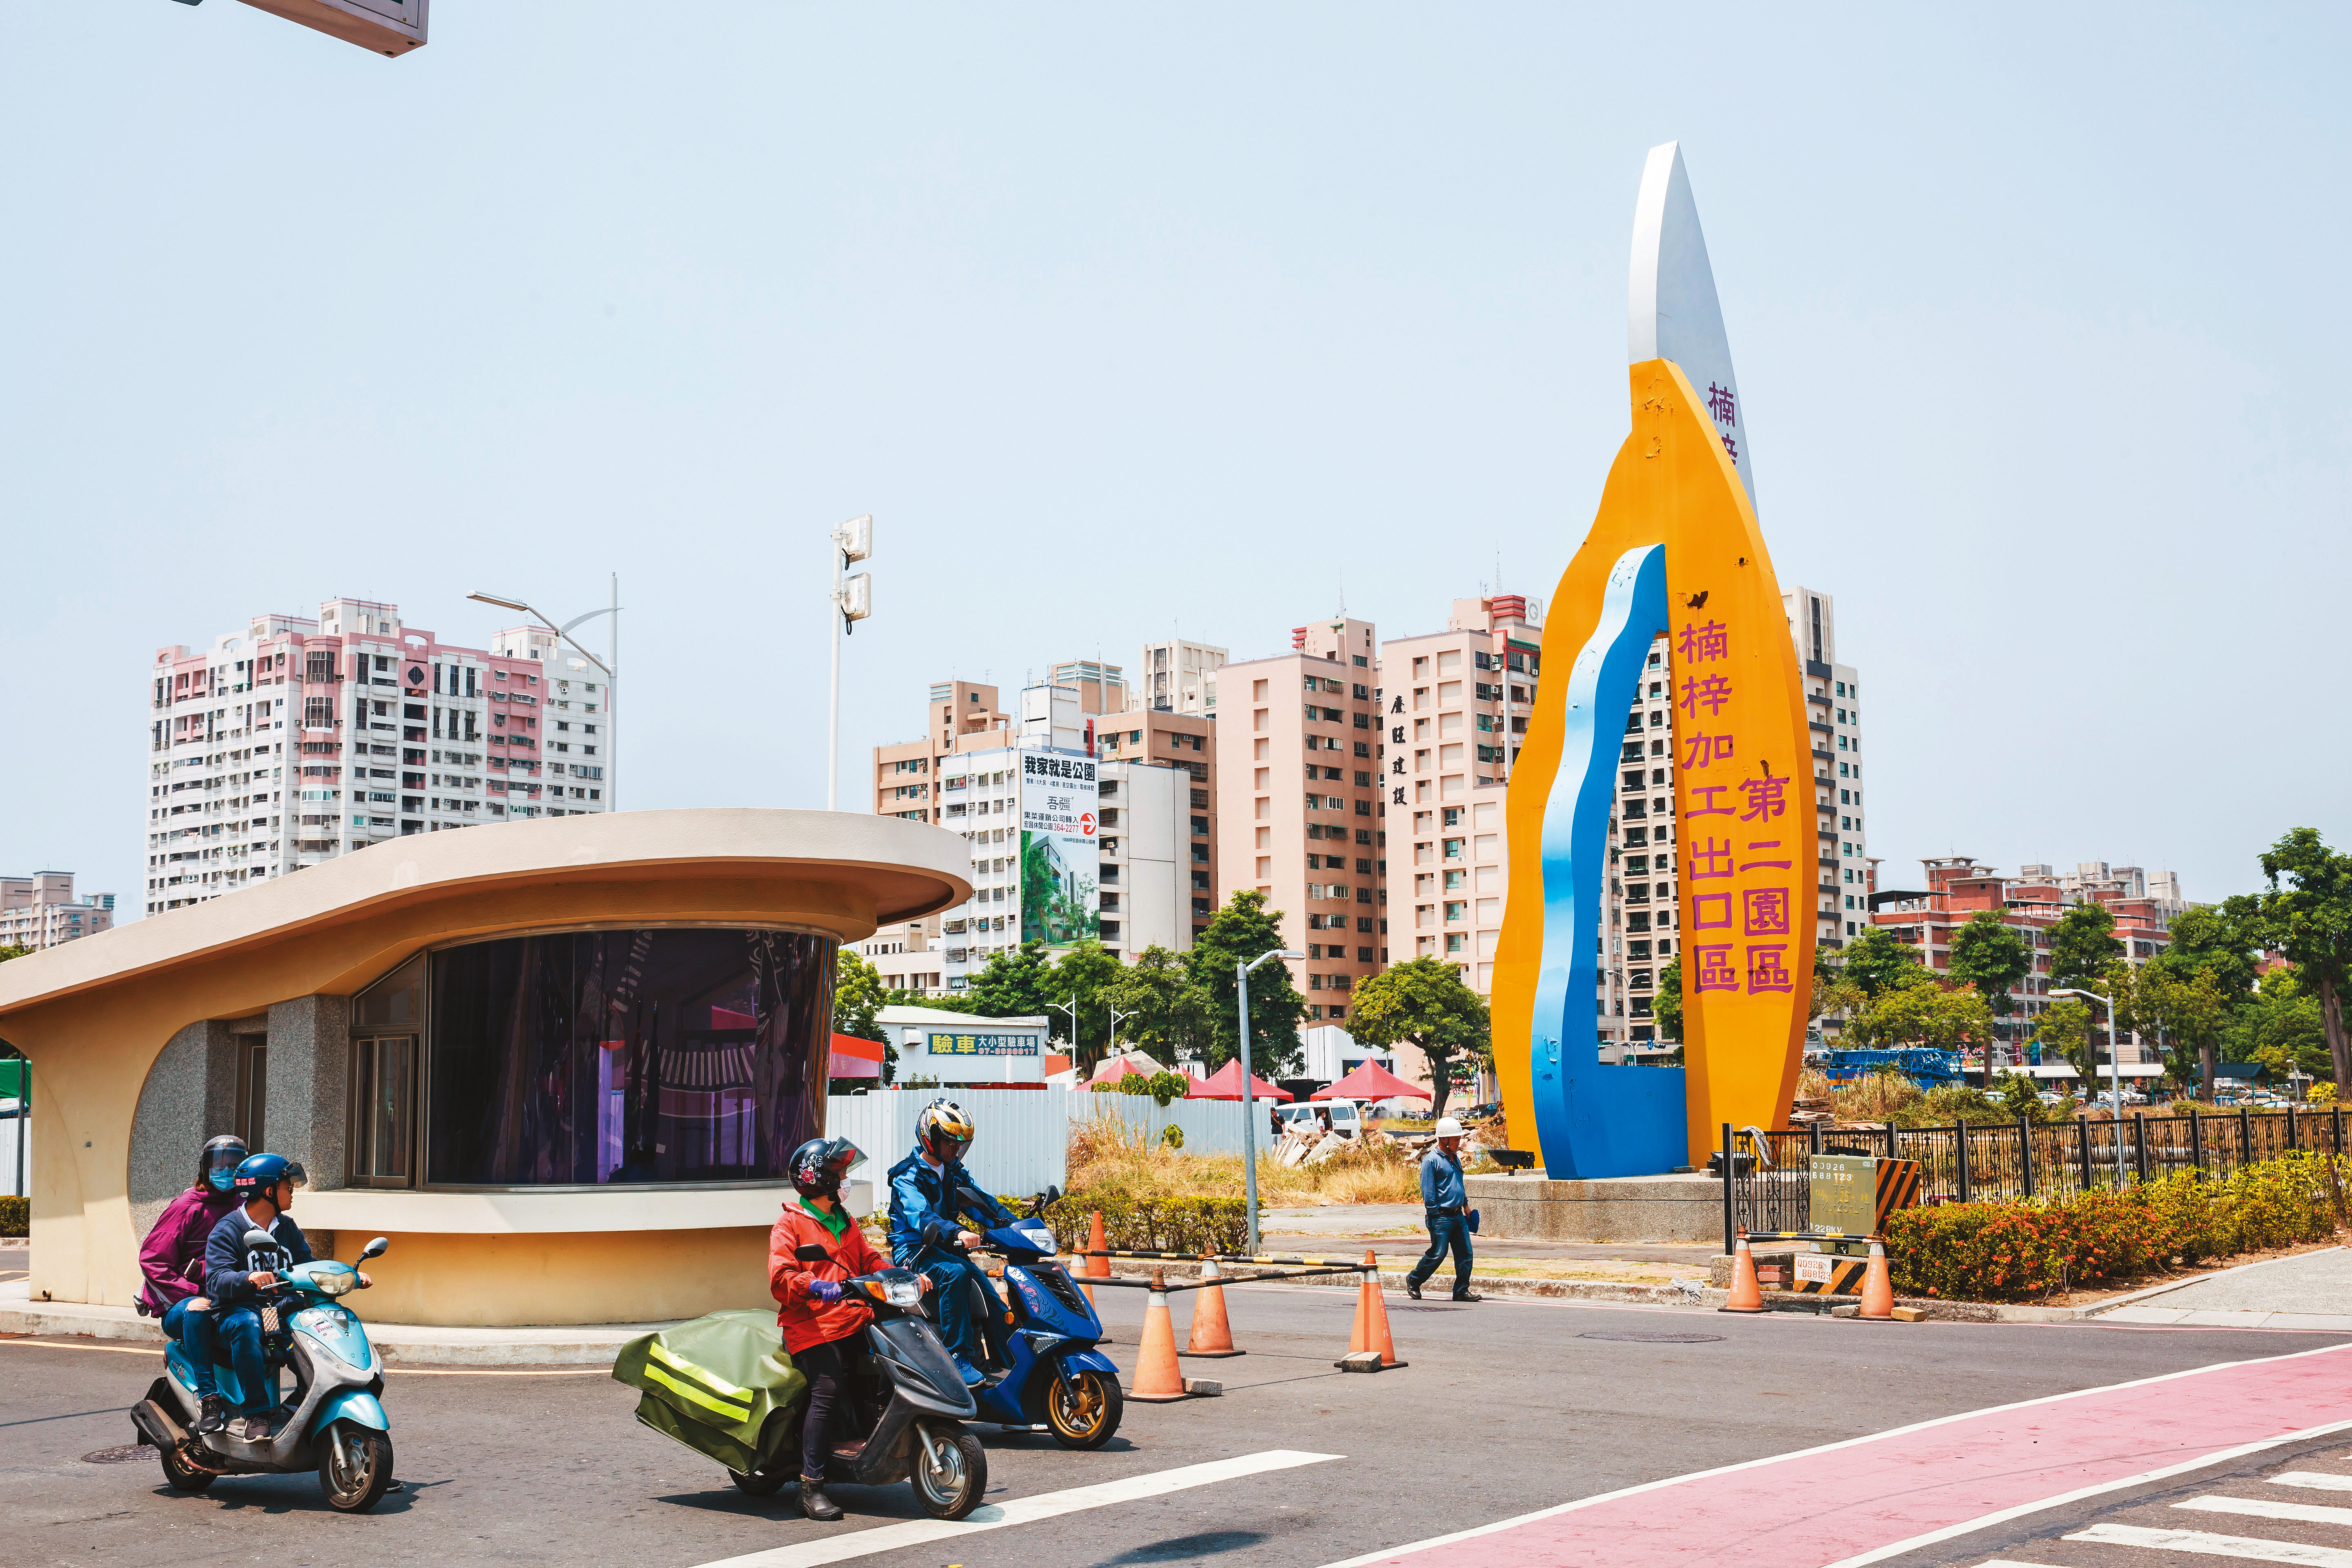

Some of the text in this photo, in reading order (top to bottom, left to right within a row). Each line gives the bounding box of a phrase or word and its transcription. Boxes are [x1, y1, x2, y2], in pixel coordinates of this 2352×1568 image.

[1025, 755, 1095, 782] 我家就是公園
[1047, 796, 1071, 811] 吾疆
[1678, 620, 1740, 994] 楠梓加工出口區
[1024, 811, 1079, 824] 果菜運銷公司轉入
[1054, 823, 1079, 833] 364-2277
[1738, 774, 1794, 995] 第二園區
[932, 1035, 1035, 1054] 驗車 大小型驗車場
[1812, 1172, 1852, 1181] BB8123
[1797, 1259, 1823, 1269] Q0926
[1802, 1269, 1831, 1280] BB8123
